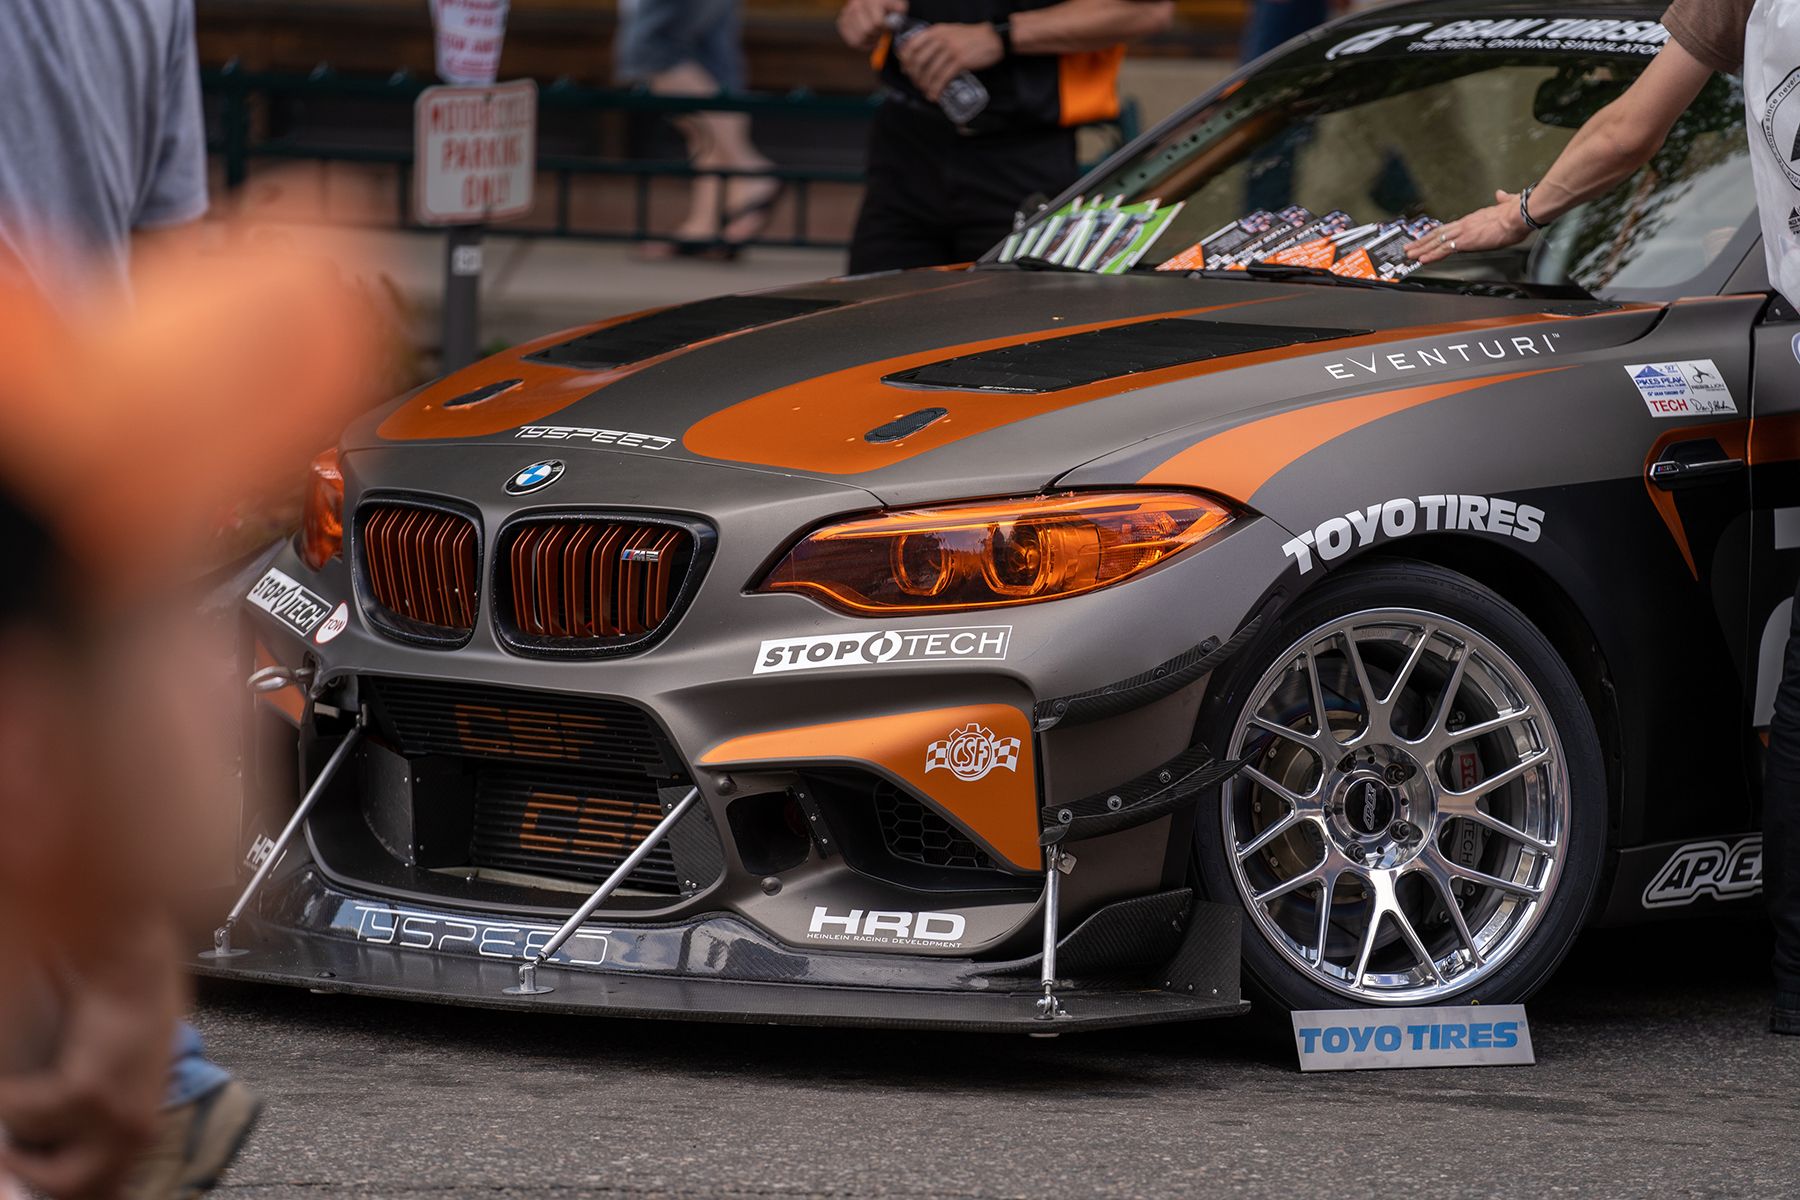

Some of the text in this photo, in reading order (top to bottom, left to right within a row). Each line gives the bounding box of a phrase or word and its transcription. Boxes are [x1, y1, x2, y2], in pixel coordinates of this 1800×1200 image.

[1527, 18, 1671, 45] TURISM
[1764, 97, 1778, 122] since
[1778, 76, 1797, 98] never
[1650, 398, 1689, 413] TECH
[1281, 494, 1546, 576] TOYO TIRES
[324, 618, 346, 632] TOW
[950, 736, 991, 769] CSF
[1462, 821, 1476, 865] TECH
[1650, 844, 1763, 899] APE
[806, 932, 963, 948] HEINLEIN RACING DEVELOPMENT
[808, 906, 966, 941] HRD
[1299, 1021, 1519, 1054] TOYO TIRES
